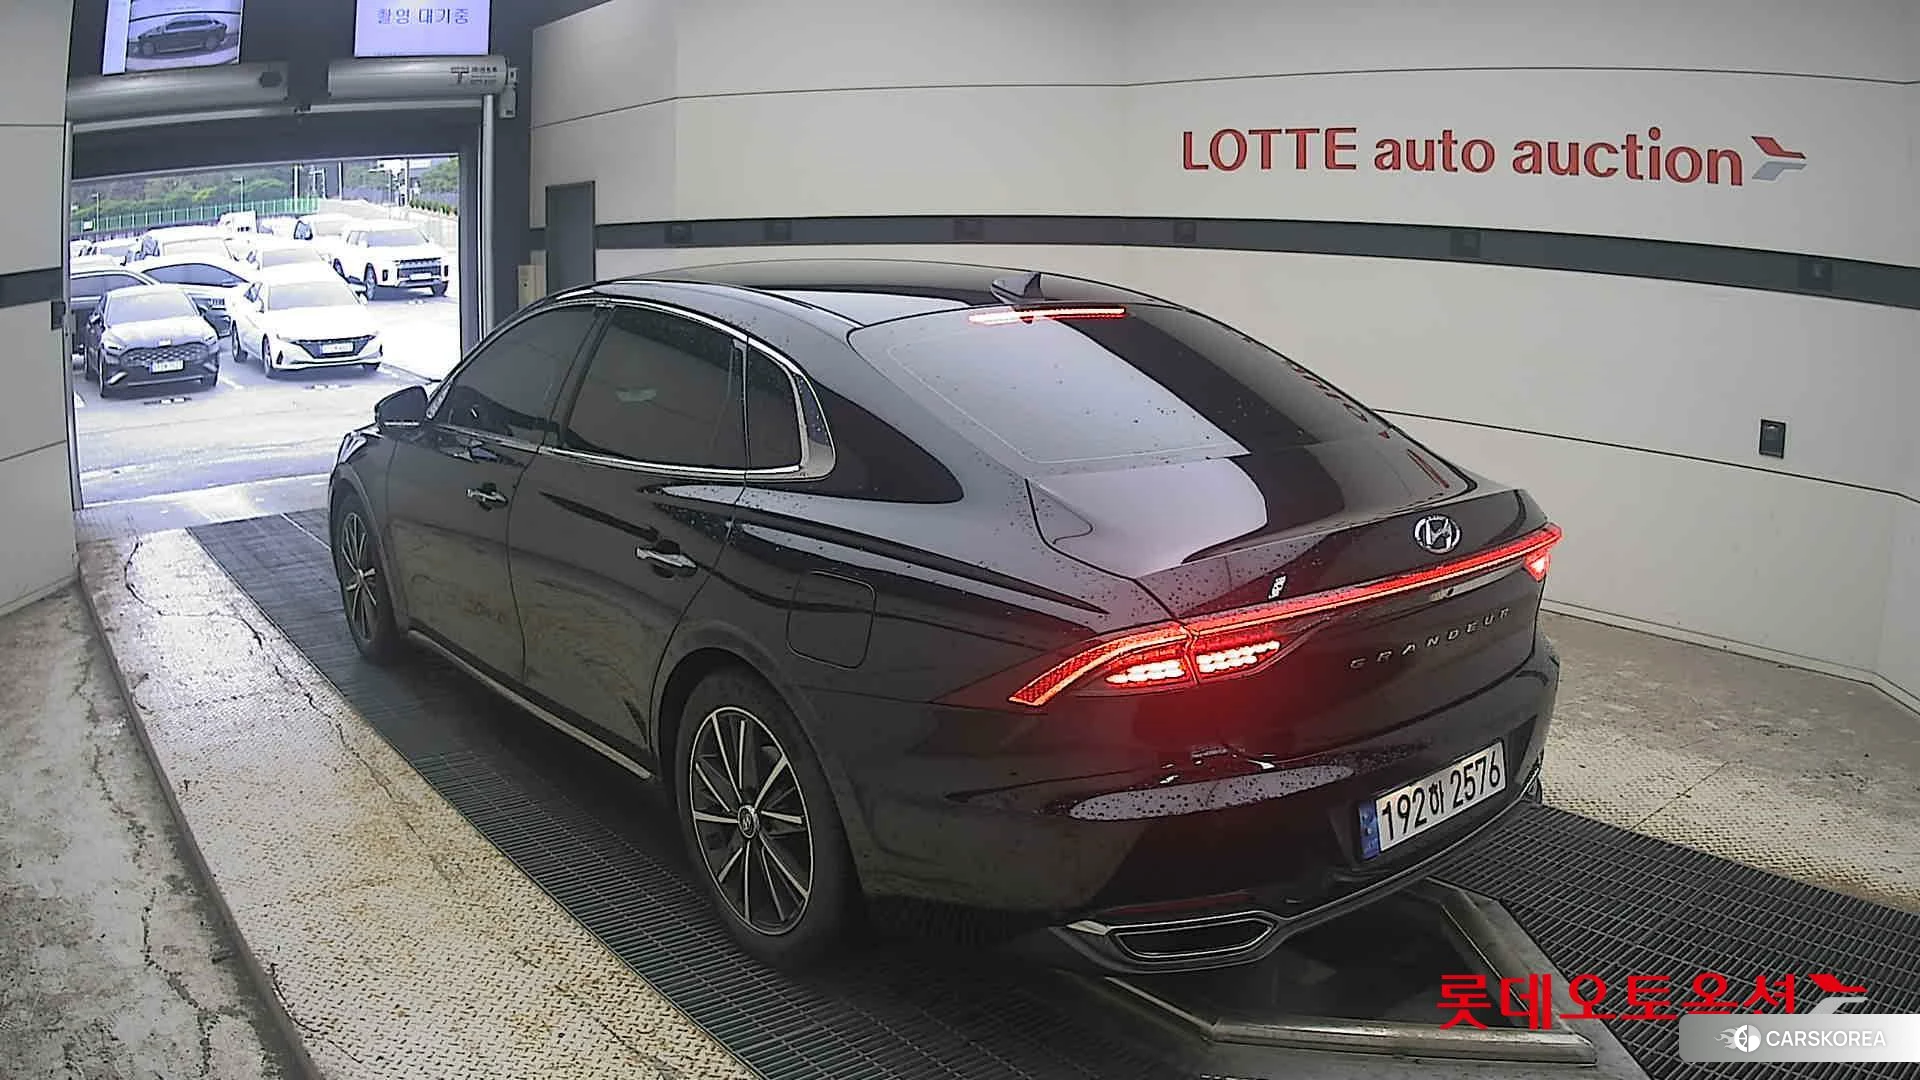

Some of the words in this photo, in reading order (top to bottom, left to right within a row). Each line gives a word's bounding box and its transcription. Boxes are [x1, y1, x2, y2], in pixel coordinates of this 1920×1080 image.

[377, 8, 410, 25] 촬영
[418, 8, 470, 25] 대기중
[1183, 127, 1358, 172] LOTTE
[1375, 130, 1496, 173] auto
[1512, 128, 1744, 186] auction
[1350, 607, 1509, 669] GRANDEUR
[1382, 779, 1444, 841] 192하
[1450, 750, 1501, 808] 2576
